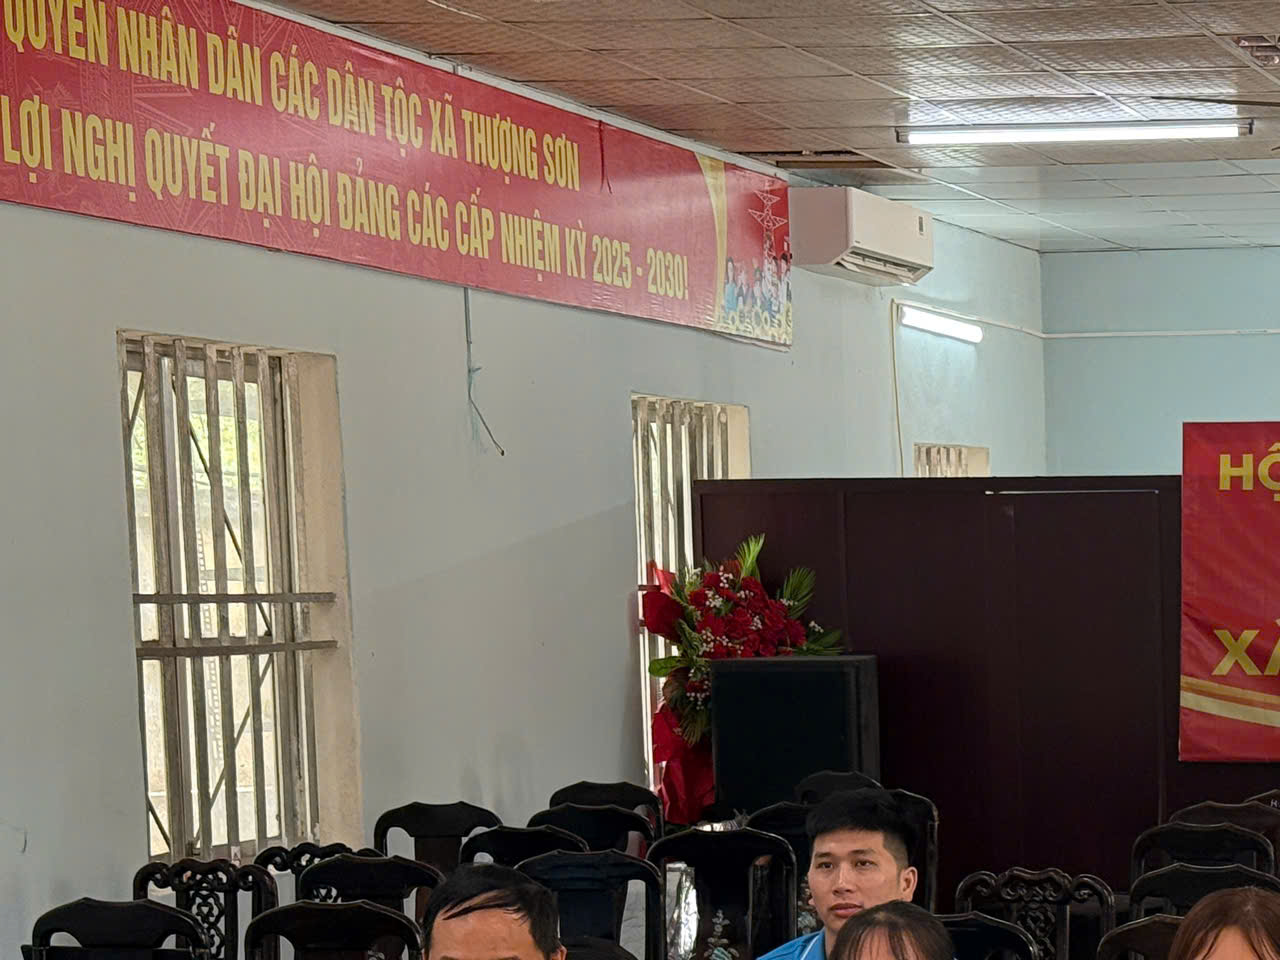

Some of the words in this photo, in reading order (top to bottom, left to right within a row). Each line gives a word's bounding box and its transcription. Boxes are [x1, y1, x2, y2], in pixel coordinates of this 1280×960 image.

[117, 5, 199, 90] NHÂN
[206, 26, 263, 106] DÂN
[269, 45, 320, 121] CÁC
[326, 60, 376, 136] DÂN
[381, 77, 424, 158] TỘC
[428, 92, 458, 159] XÃ
[460, 108, 539, 185] THƯỢNG
[542, 132, 580, 192] SƠN
[1, 95, 53, 184] LỢI
[61, 108, 137, 202] NGHỊ
[144, 122, 230, 206] QUYẾT
[238, 149, 282, 229] ĐẠI
[289, 153, 332, 237] HỘI
[336, 157, 401, 241] ĐẢNG
[406, 182, 450, 251] CÁC
[455, 186, 495, 259] CẤP
[500, 208, 562, 282] NHIỆM
[565, 218, 588, 280] KỲ
[592, 234, 632, 289] 2025
[646, 247, 689, 301] 2030!
